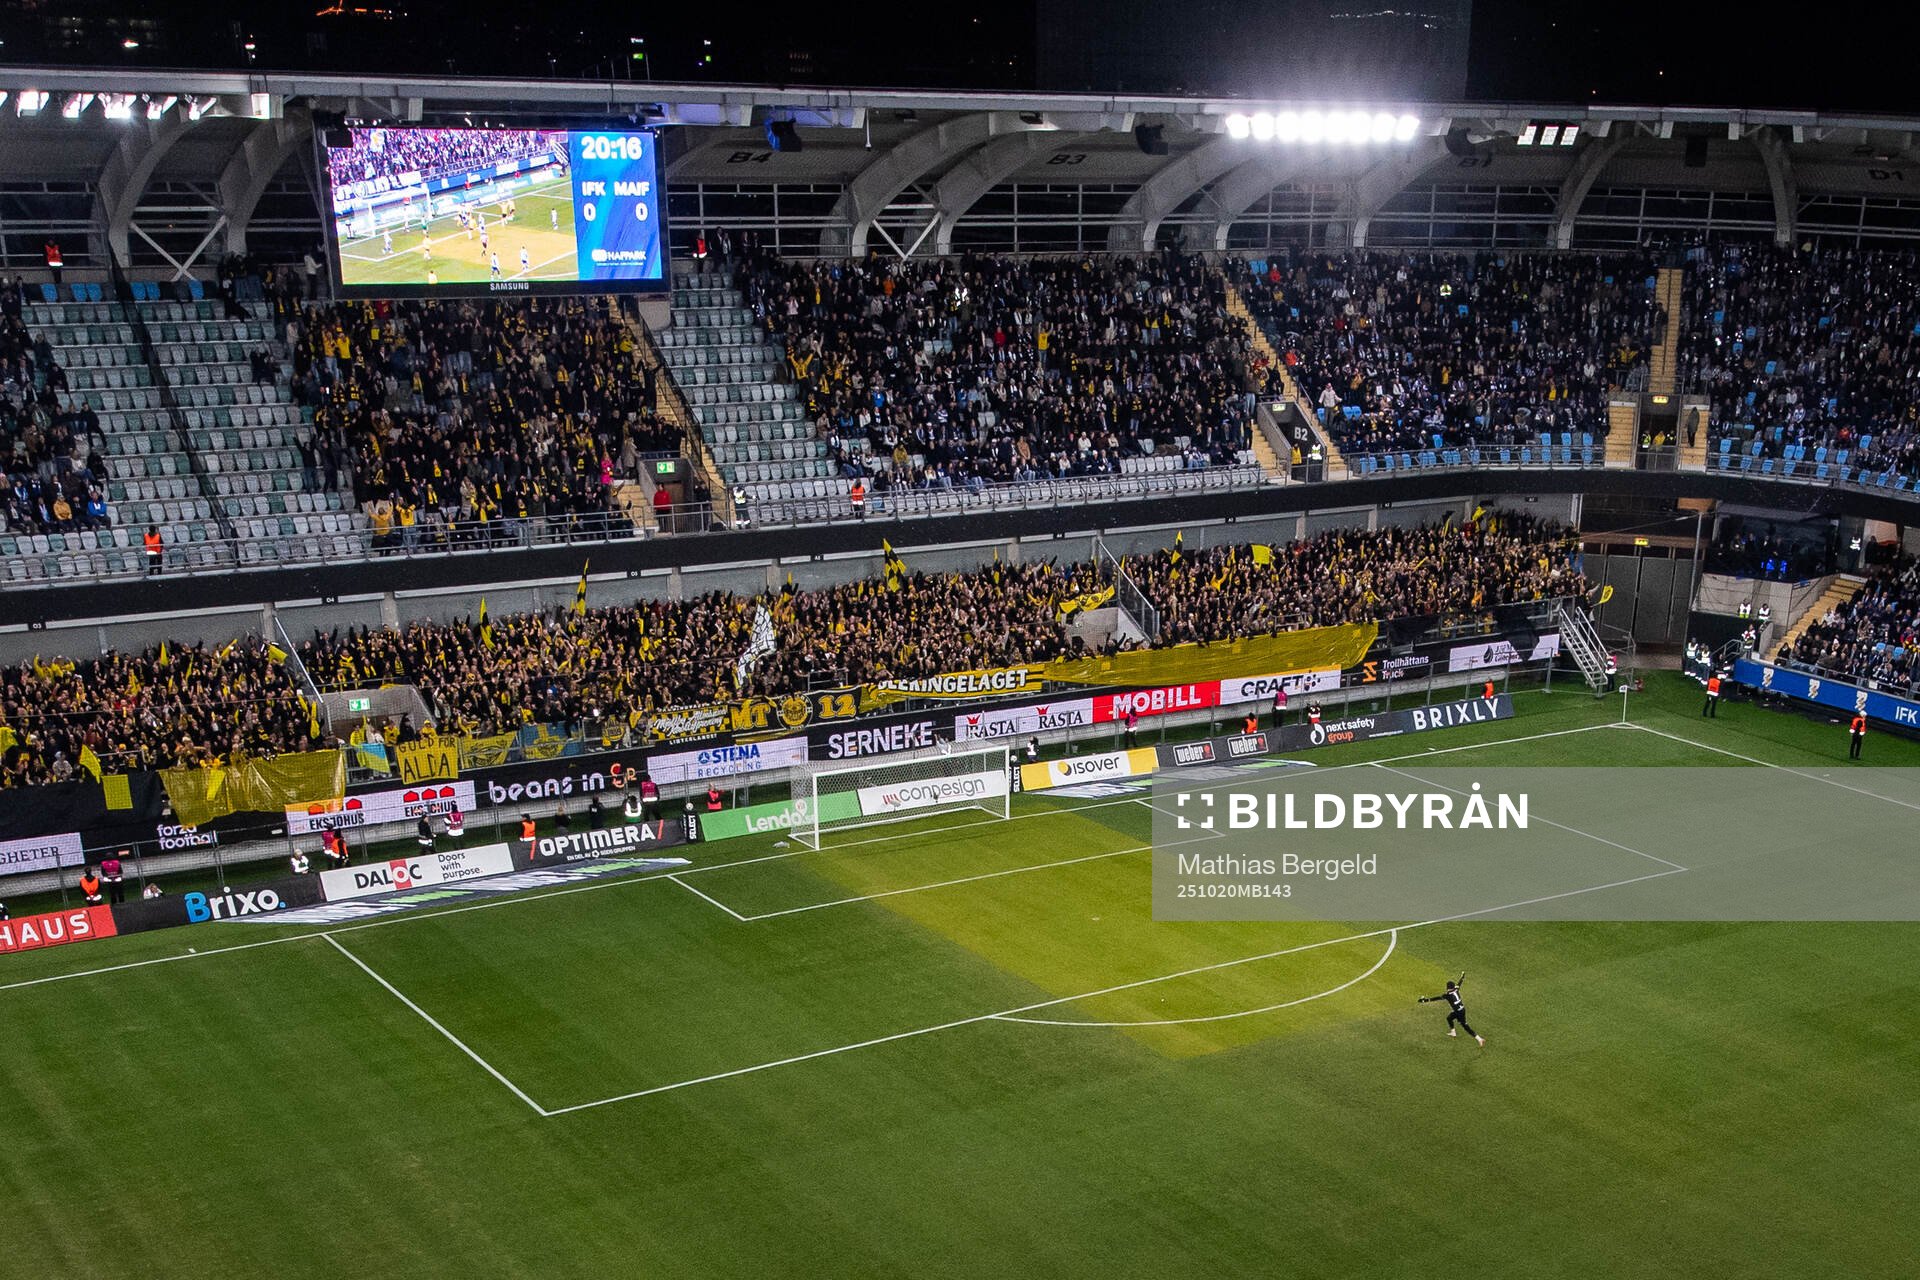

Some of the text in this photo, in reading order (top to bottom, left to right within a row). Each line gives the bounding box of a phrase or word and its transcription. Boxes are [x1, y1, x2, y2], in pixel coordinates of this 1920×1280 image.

[581, 136, 643, 160] 20:16
[581, 181, 650, 197] IFK MAIF
[583, 203, 649, 222] 0 0
[489, 282, 530, 291] SAMSUNG
[1294, 426, 1308, 441] B2
[1240, 674, 1303, 697] CRAFT
[819, 694, 856, 718] 12
[1112, 685, 1201, 719] MOBILL
[731, 700, 771, 730] MT
[1039, 710, 1084, 729] RASTA
[1412, 698, 1499, 731] BRIXLY
[1895, 706, 1918, 724] IFK
[969, 719, 1017, 739] RASTA
[1327, 731, 1354, 744] group
[828, 721, 935, 759] SERNEKE
[1230, 735, 1259, 755] weber
[712, 744, 760, 764] STENA
[1176, 744, 1205, 763] weber
[403, 753, 451, 783] ALDA
[698, 761, 761, 777] RECYCLNG
[488, 777, 572, 803] beans
[582, 771, 605, 792] in
[745, 808, 803, 833] Lendo
[539, 823, 656, 857] OPTIMERA
[438, 853, 466, 863] Doors
[441, 860, 461, 872] with
[354, 864, 422, 889] DALOC
[1448, 991, 1462, 1005] 1
